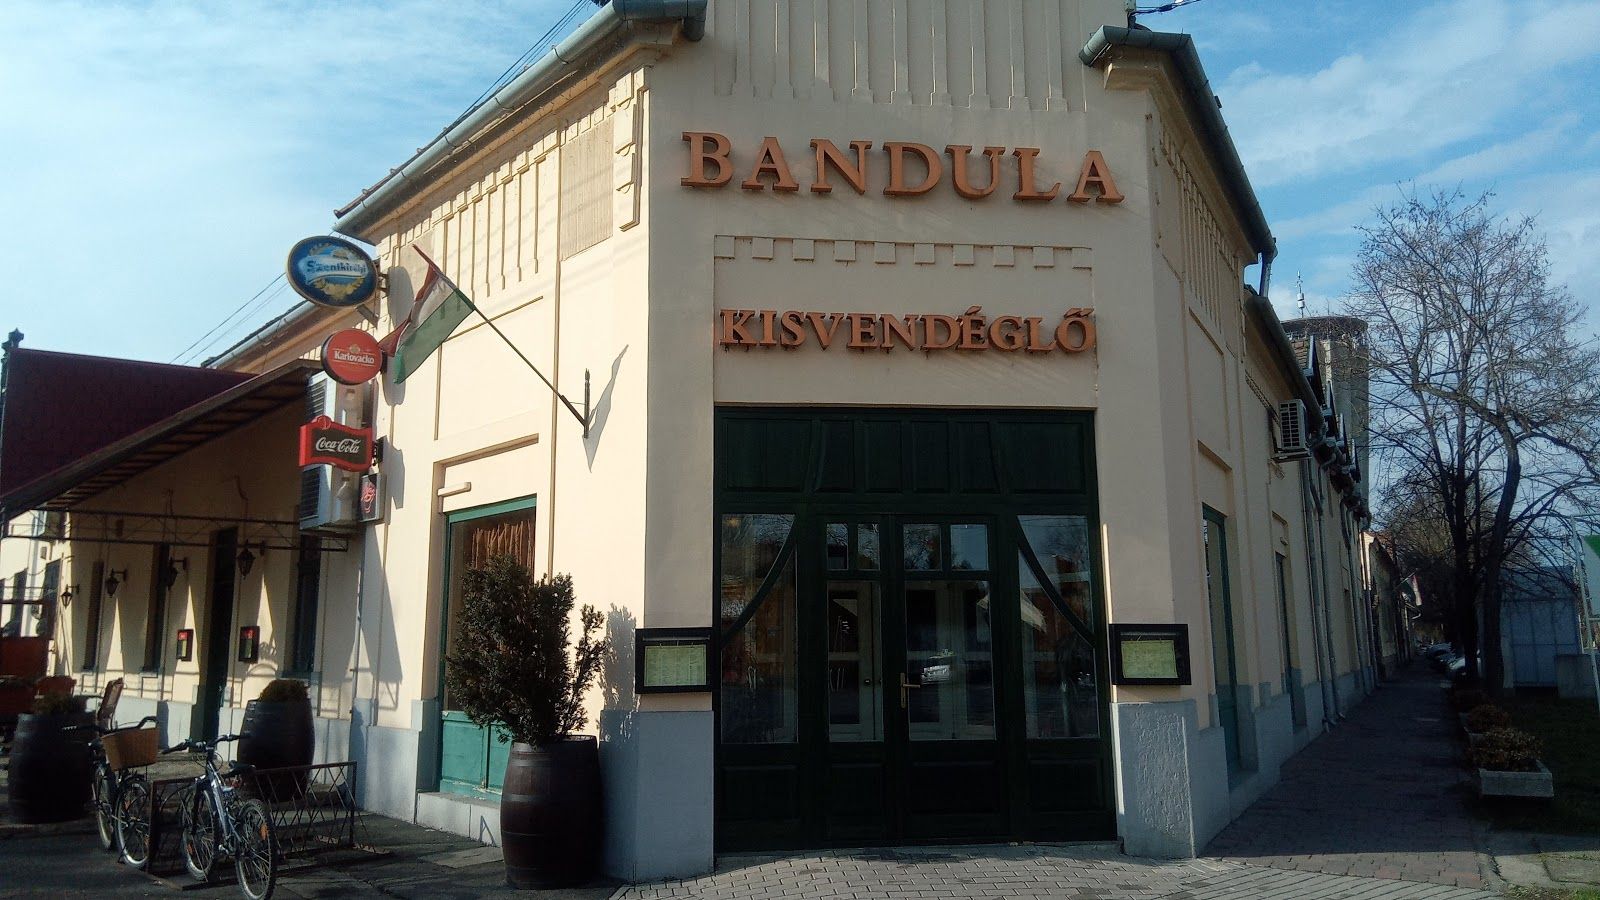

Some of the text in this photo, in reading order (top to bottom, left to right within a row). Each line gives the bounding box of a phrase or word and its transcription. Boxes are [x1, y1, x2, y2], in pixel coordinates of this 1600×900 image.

[681, 131, 1125, 204] BANDULA
[719, 305, 1096, 354] KISVENDÉGLŐ
[315, 436, 361, 454] Coca-Cola
